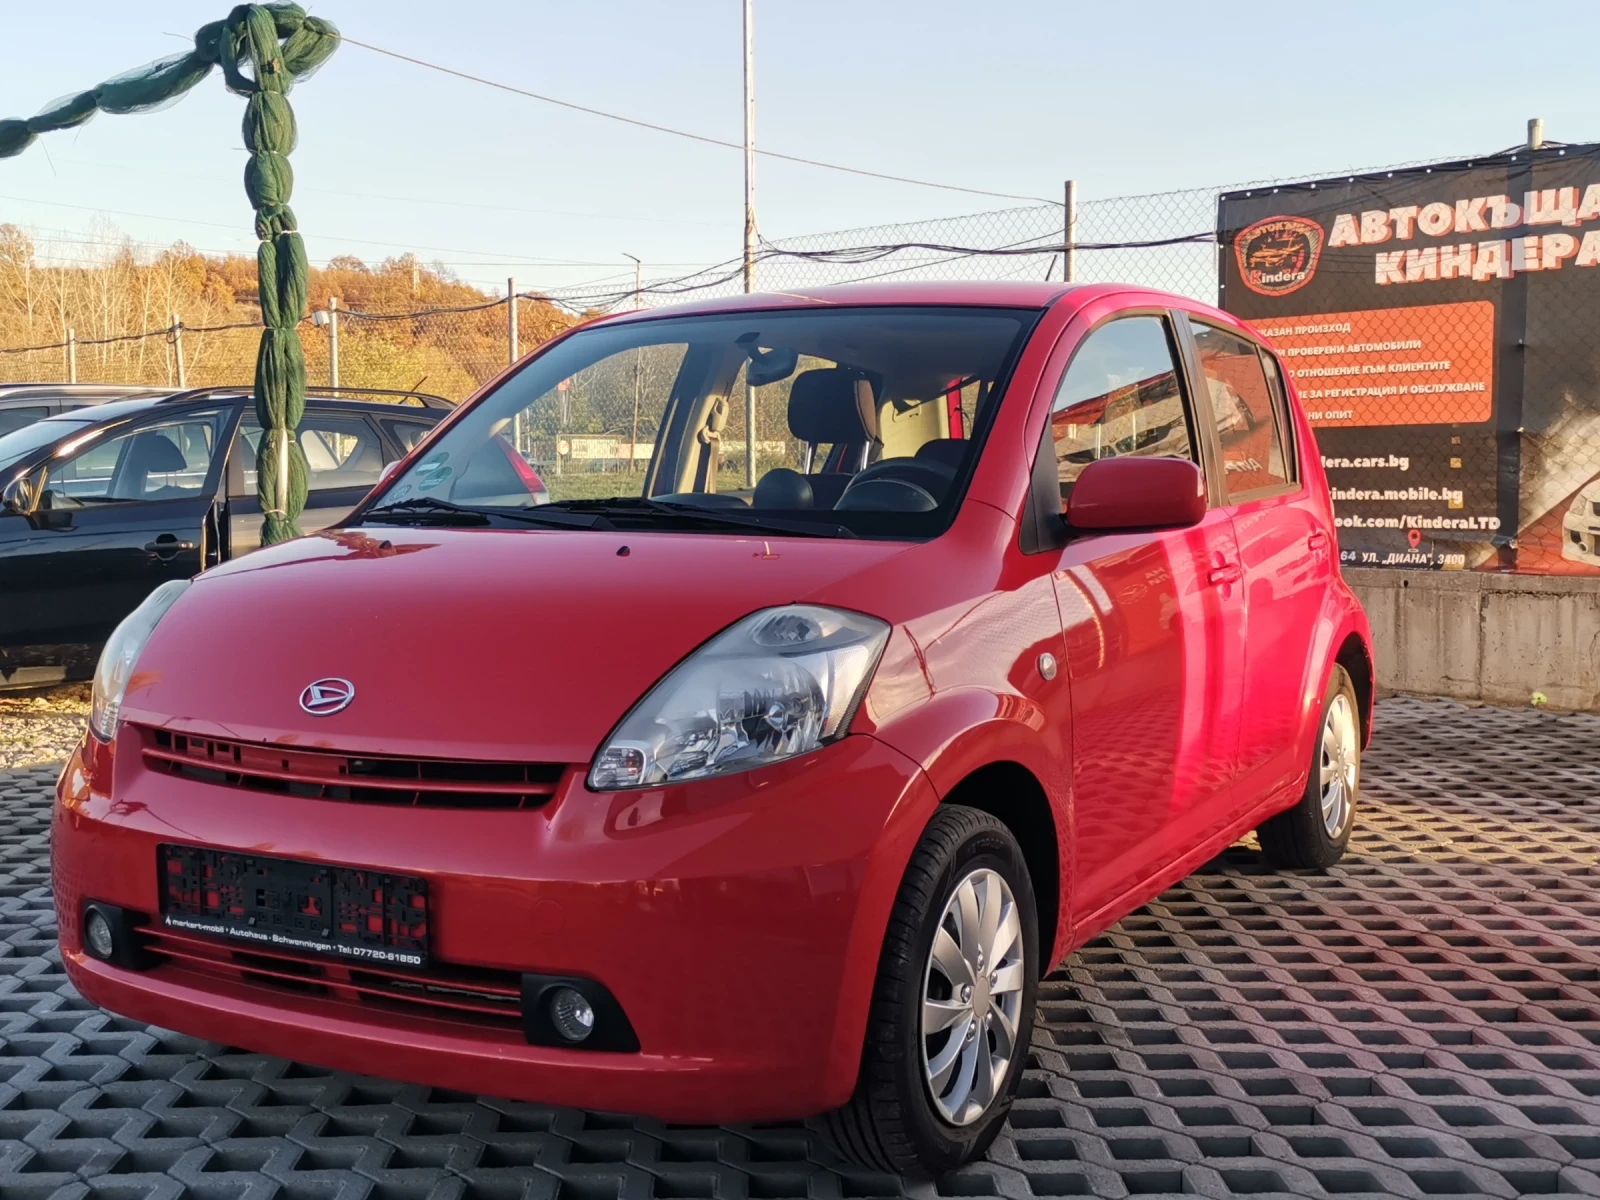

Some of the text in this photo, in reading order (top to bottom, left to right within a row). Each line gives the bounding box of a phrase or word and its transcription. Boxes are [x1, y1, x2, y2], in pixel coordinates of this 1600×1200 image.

[1328, 183, 1600, 248] АВТОКЪЩА
[1375, 229, 1600, 285] КИНДЕРА
[1250, 269, 1305, 284] Kindera
[1258, 322, 1351, 337] КАЗАН ПРОИЗХОД
[1288, 345, 1344, 357] ПРОВЕРЕНИ
[1347, 340, 1421, 353] АВТОМОБИЛИ
[1297, 366, 1360, 378] ОТНОШЕНИЕ
[1362, 364, 1386, 375] КЪМ
[1388, 361, 1451, 372] КЛИЕНТИТЕ
[1310, 389, 1323, 398] ЗА
[1325, 386, 1397, 398] РЕГИСТРАЦИЯ
[1399, 385, 1408, 395] И
[1410, 382, 1485, 394] ОБСЛУЖВАНЕ
[1325, 410, 1353, 419] ОПИТ
[1329, 487, 1463, 505] indera.mobile.bg
[1334, 515, 1501, 530] ook.com/KinderaLTD
[1340, 551, 1356, 561] 64
[1362, 552, 1379, 563] УЛ.
[1437, 554, 1465, 565] 3400
[229, 927, 268, 941] Autohaus
[272, 934, 331, 951] Schwenningen
[353, 948, 421, 965] 07720-61850
